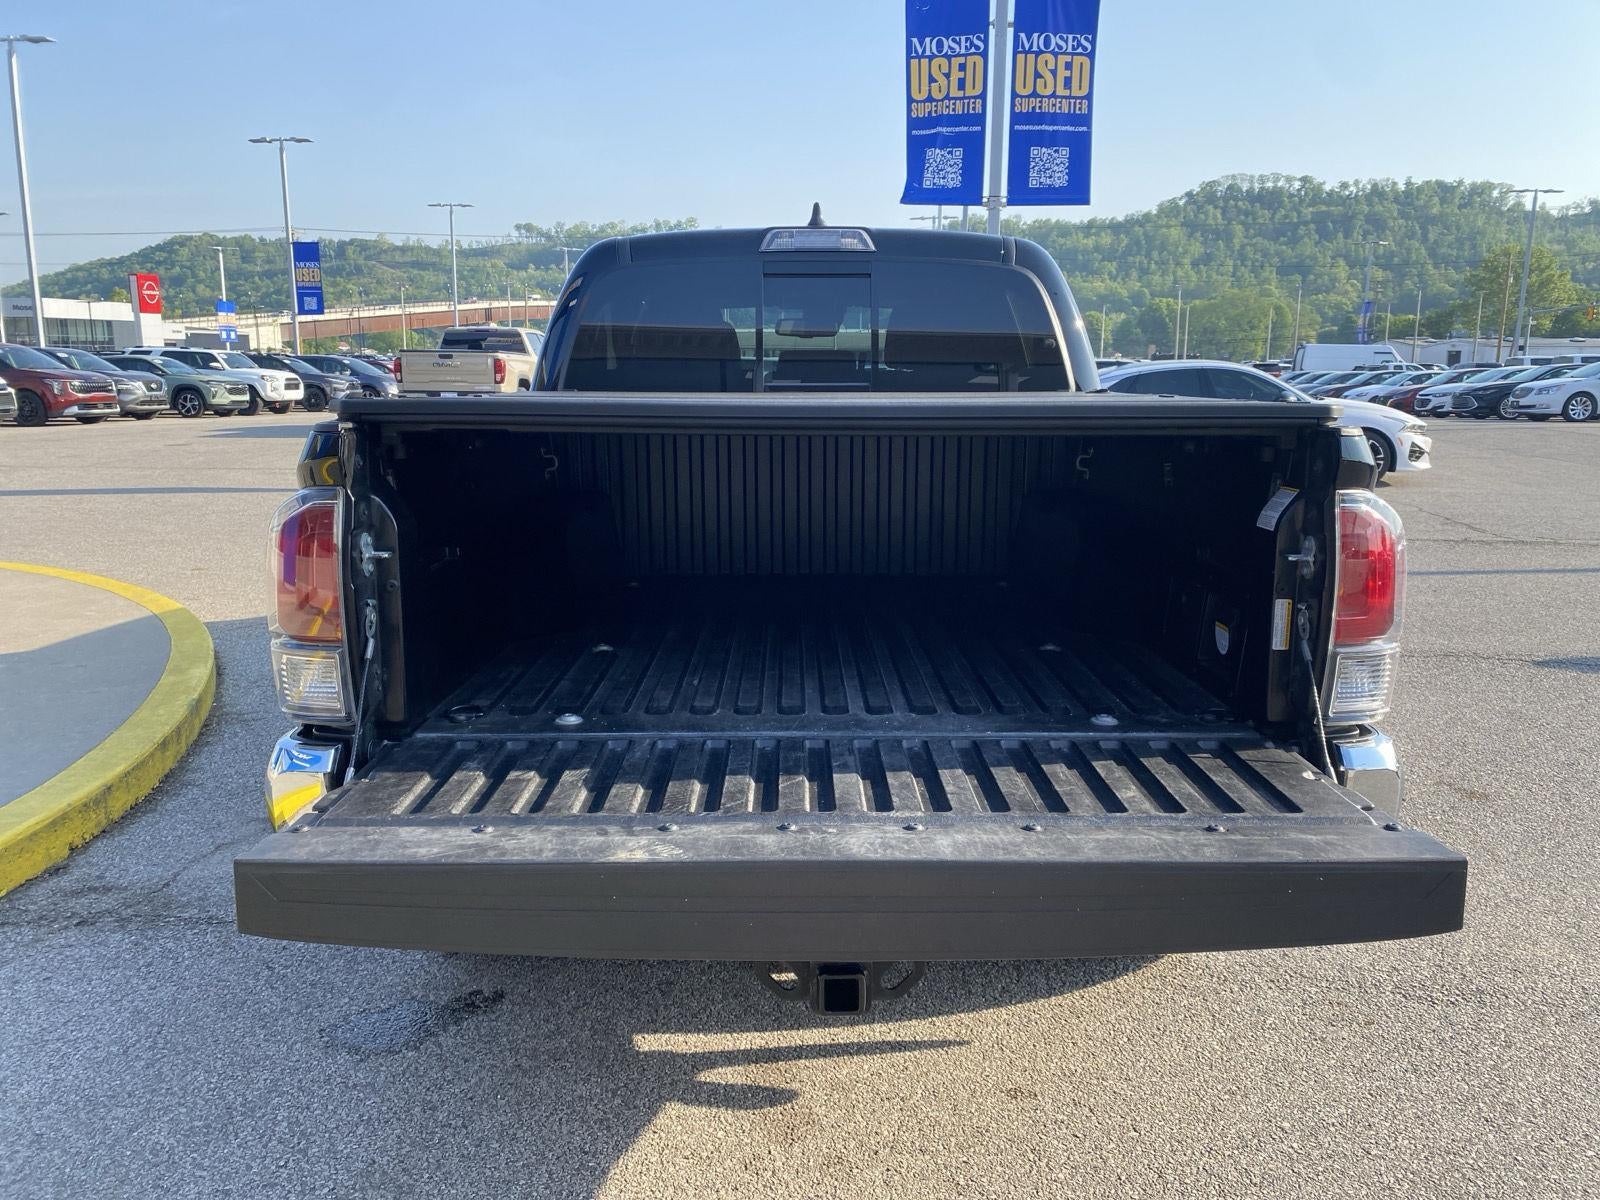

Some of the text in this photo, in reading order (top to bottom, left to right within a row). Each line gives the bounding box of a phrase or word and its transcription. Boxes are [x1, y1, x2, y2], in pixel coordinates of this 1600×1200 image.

[910, 33, 984, 56] MOSES
[1017, 32, 1092, 54] MOSES
[910, 56, 984, 100] USED
[1015, 53, 1090, 97] USED
[911, 98, 982, 118] SUPERCENTER
[1014, 97, 1088, 115] SUPERCENTER
[1014, 124, 1088, 132] mosesusedsupercenter.com
[296, 261, 320, 269] MOSES
[296, 268, 321, 282] USED
